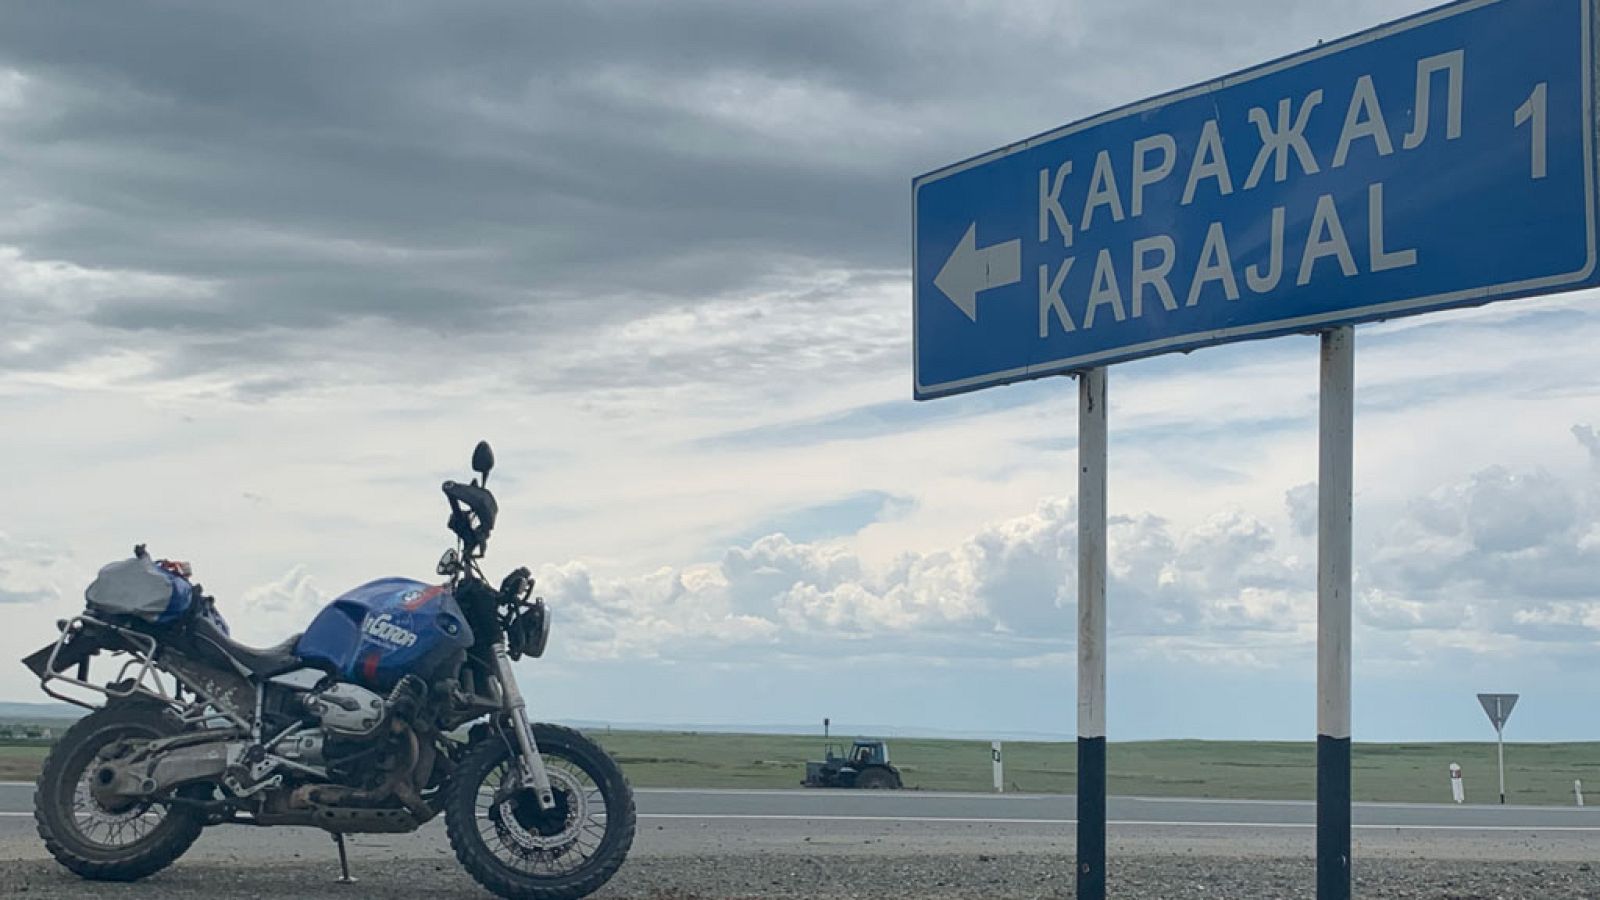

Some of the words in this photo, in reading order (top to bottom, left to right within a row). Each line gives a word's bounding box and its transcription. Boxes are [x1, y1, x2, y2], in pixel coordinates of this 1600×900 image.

[1037, 49, 1465, 247] ҚАРАЖАЛ
[1513, 82, 1549, 180] 1
[1038, 184, 1417, 338] KARAJAL
